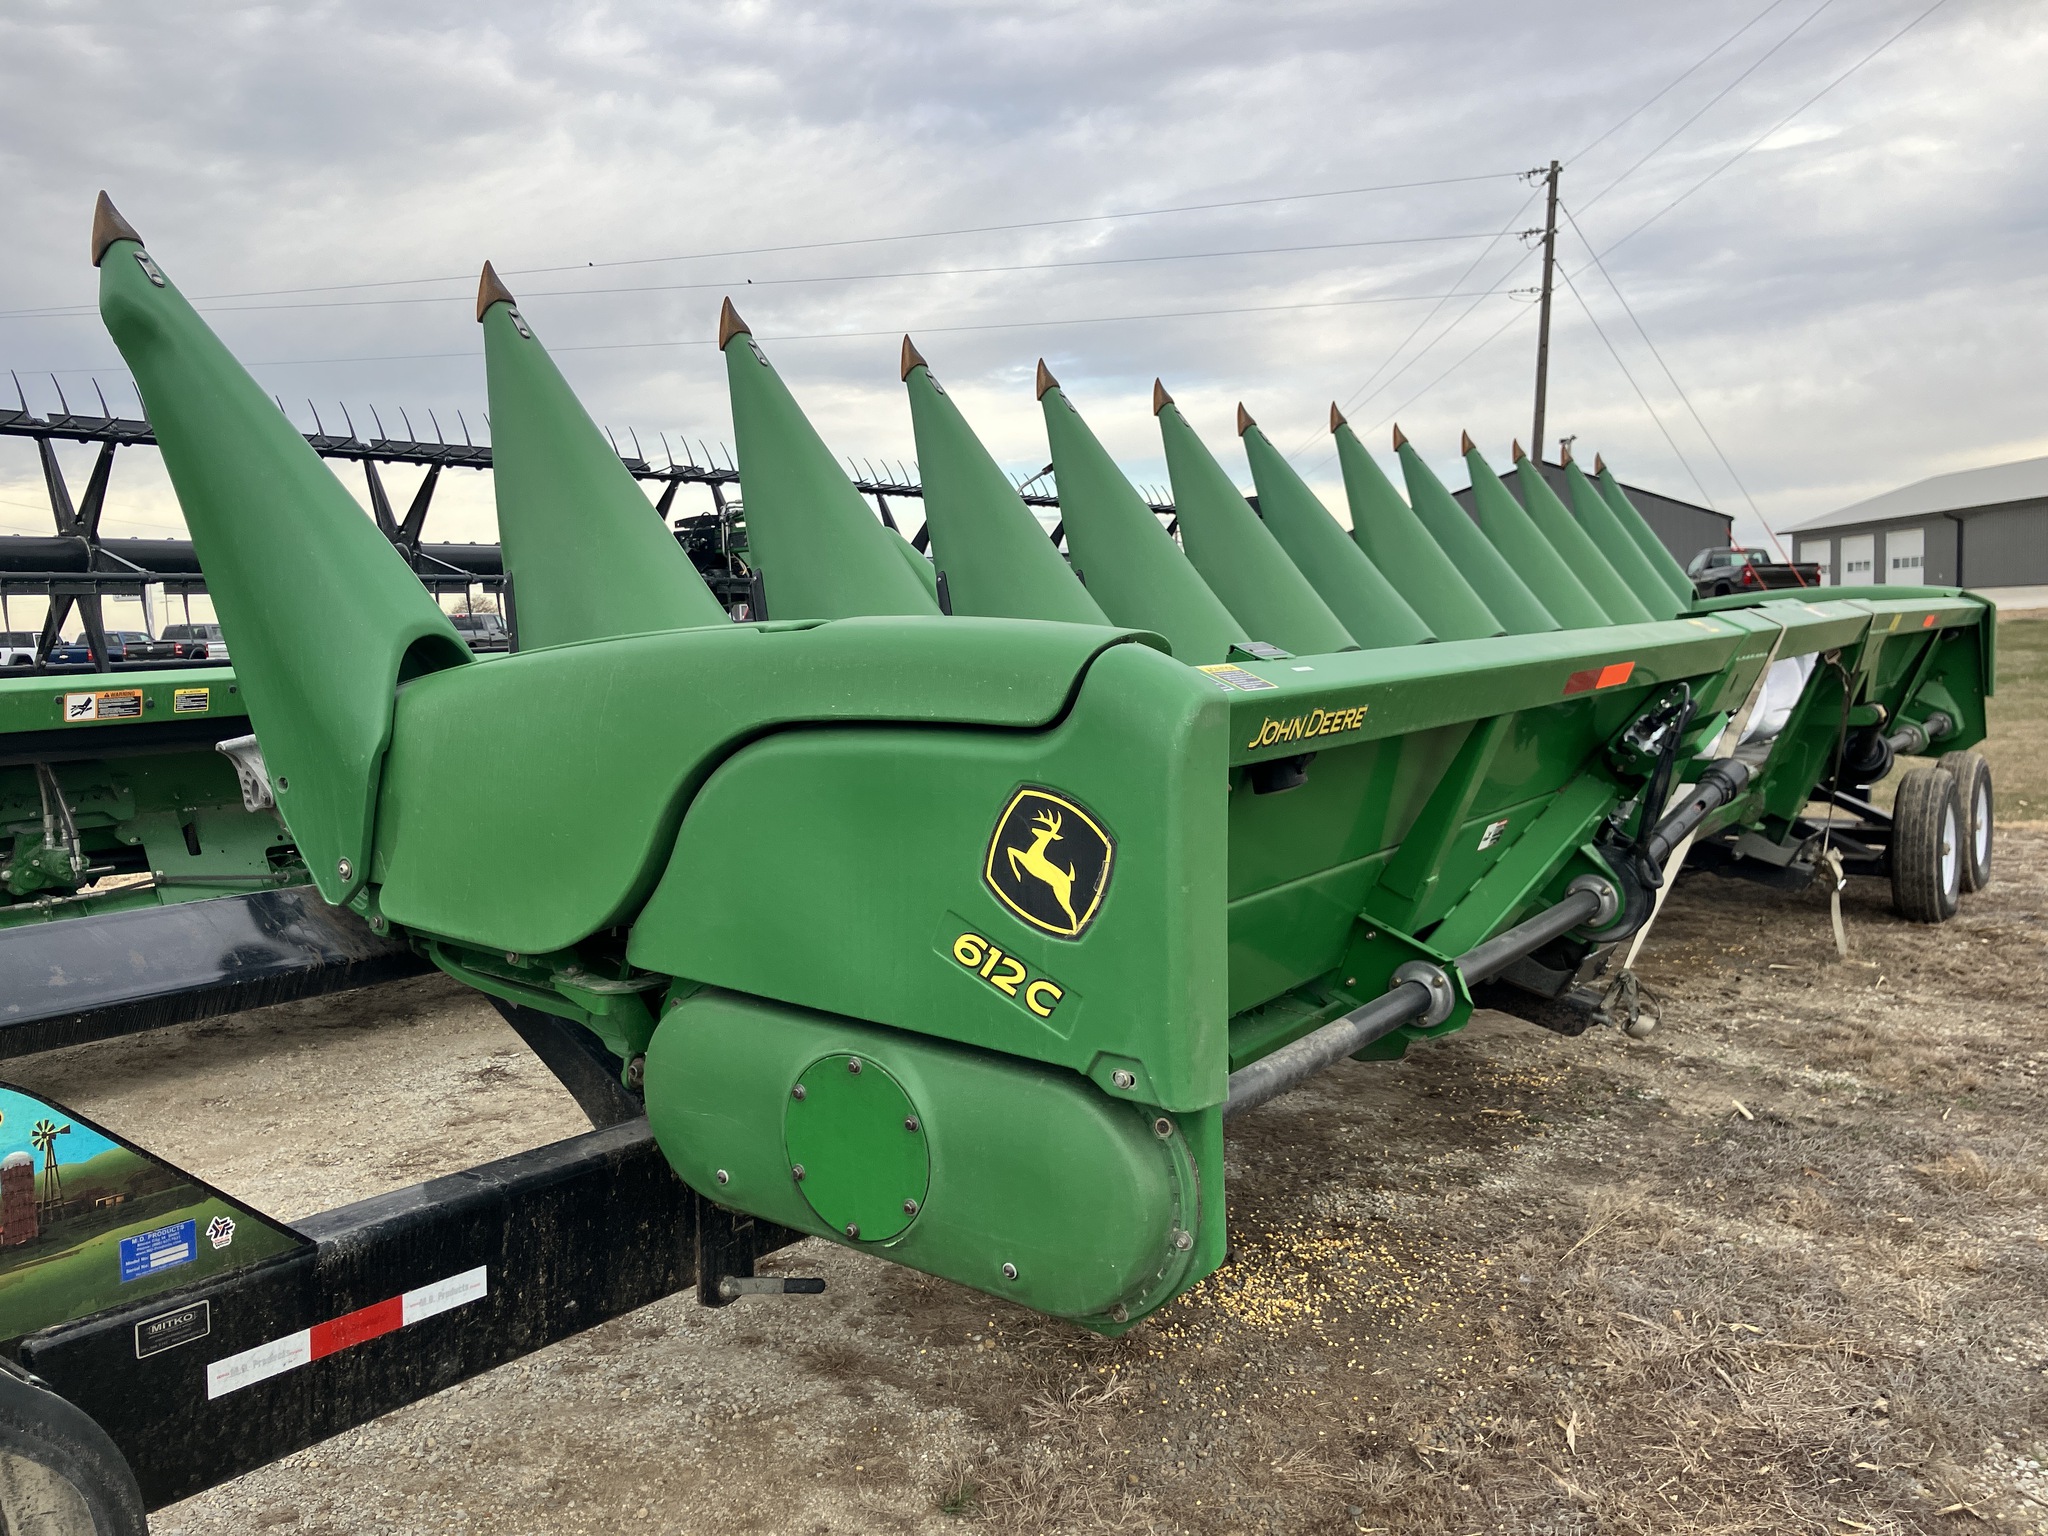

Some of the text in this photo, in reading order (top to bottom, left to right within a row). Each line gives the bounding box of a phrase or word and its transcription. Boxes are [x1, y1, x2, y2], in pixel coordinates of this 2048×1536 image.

[1248, 705, 1369, 750] JOHN DEERE
[147, 1224, 185, 1240] PRODUCTS
[151, 1313, 193, 1334] MITKO
